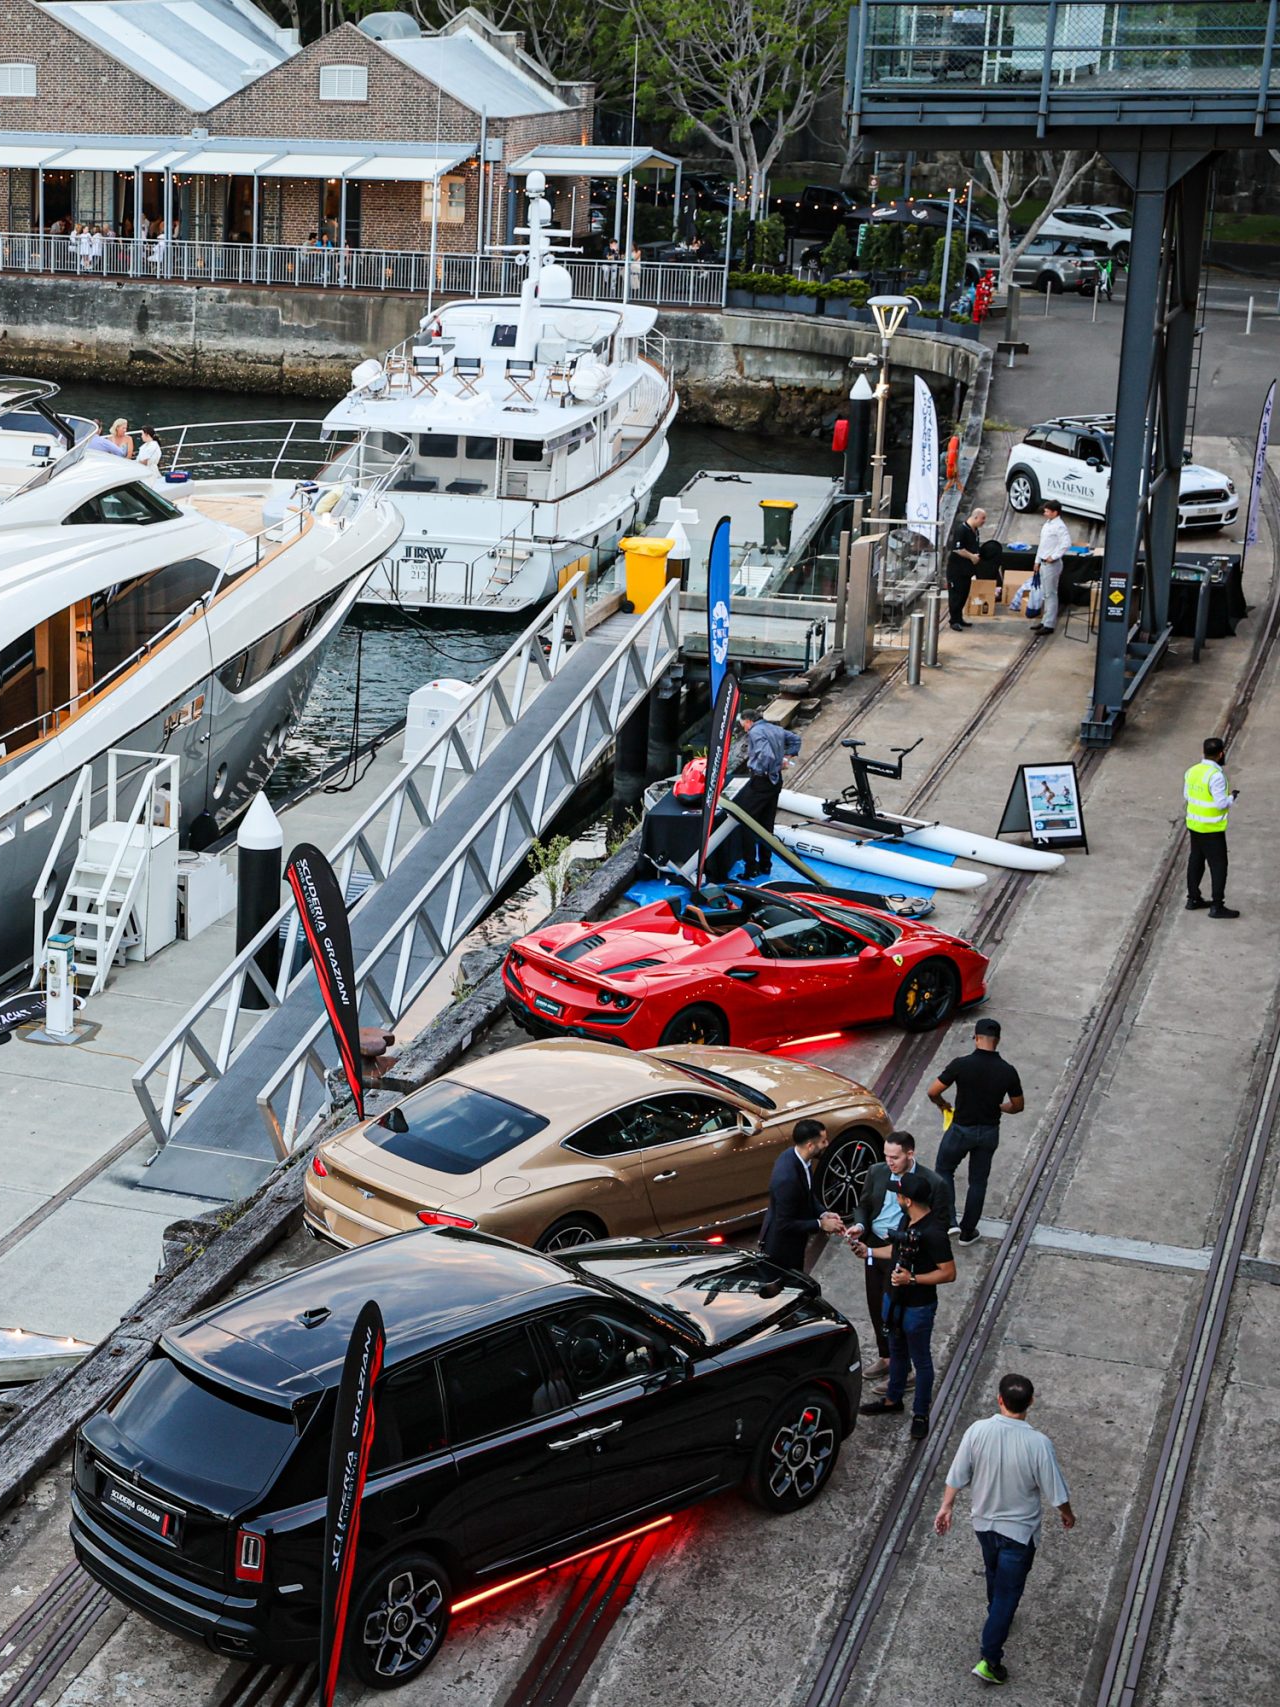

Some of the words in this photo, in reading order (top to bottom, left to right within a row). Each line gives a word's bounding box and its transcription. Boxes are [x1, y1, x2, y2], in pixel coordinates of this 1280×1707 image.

[1047, 478, 1095, 497] PANTAENIUS
[300, 858, 328, 933] SCUDERIA
[324, 937, 351, 1006] GRAZIANI
[351, 1326, 373, 1438] GRAZIANI
[110, 1489, 136, 1509] SCUDERIA
[136, 1504, 161, 1523] GRAZIANI
